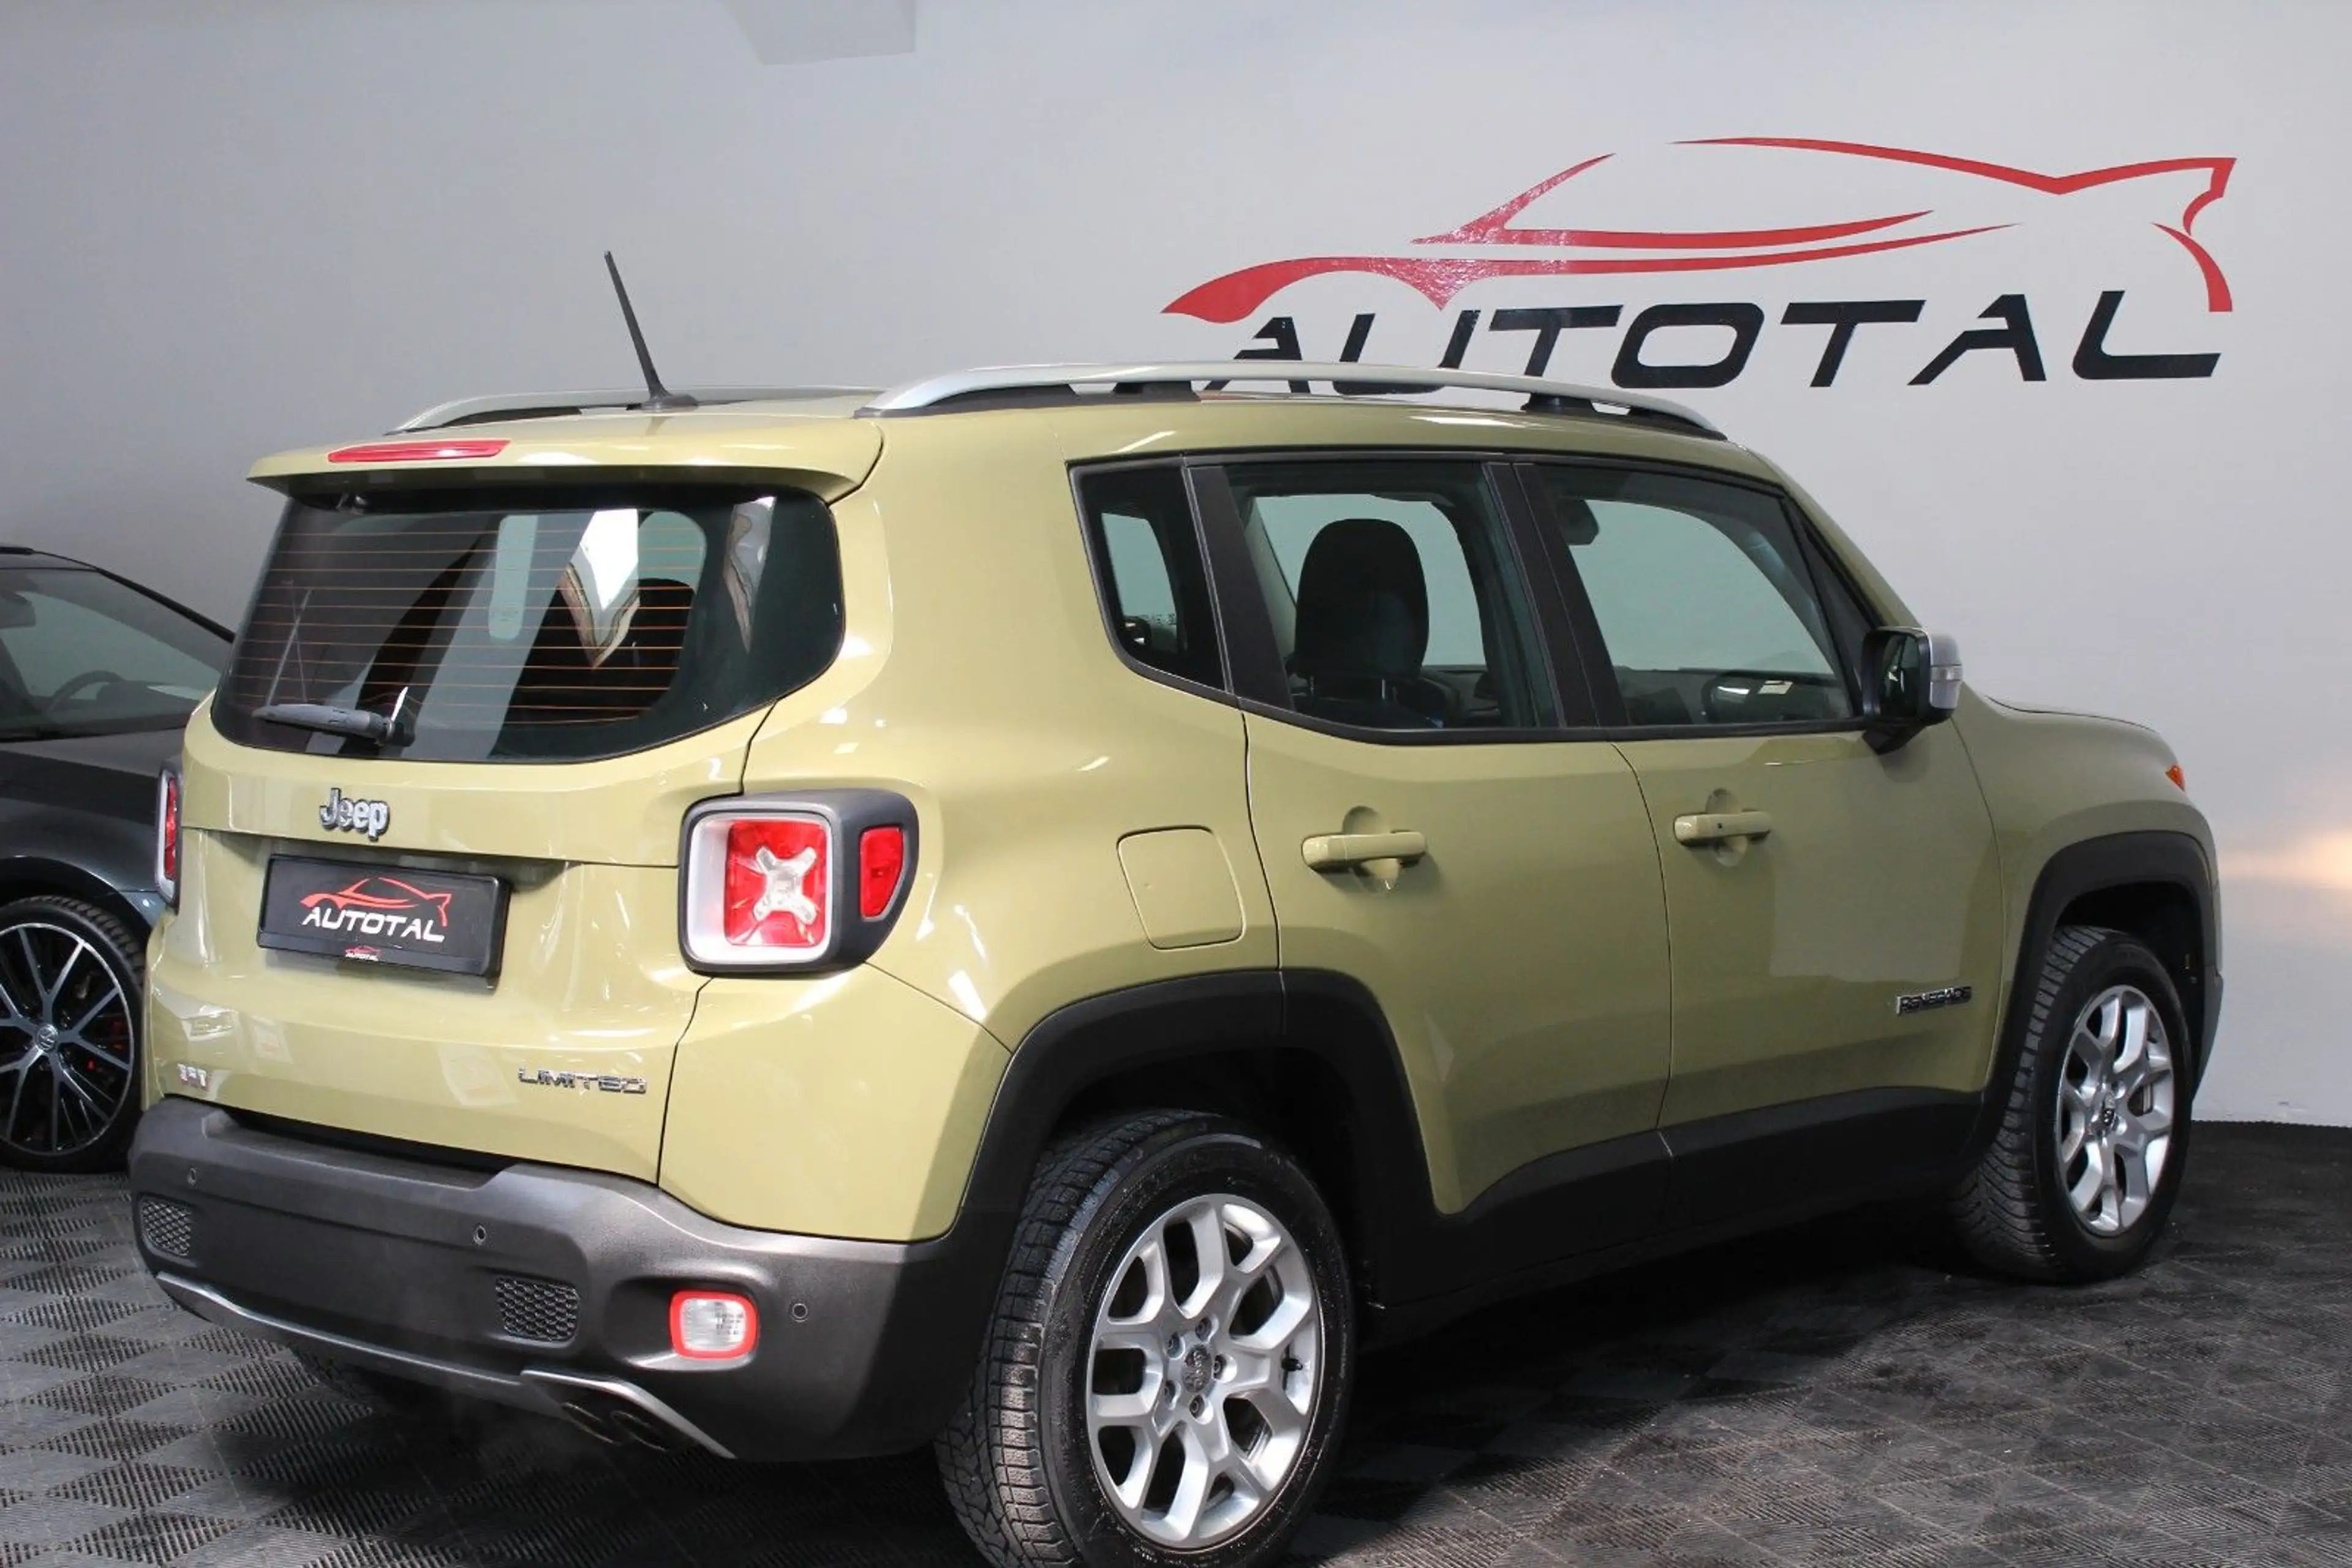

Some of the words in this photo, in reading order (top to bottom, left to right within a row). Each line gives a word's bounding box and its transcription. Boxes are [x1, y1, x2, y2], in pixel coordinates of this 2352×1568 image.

[1203, 290, 2222, 393] AUTOTAL
[319, 788, 390, 842] Jeep
[302, 906, 445, 943] AUTOTAL
[518, 1066, 647, 1095] LIMITED
